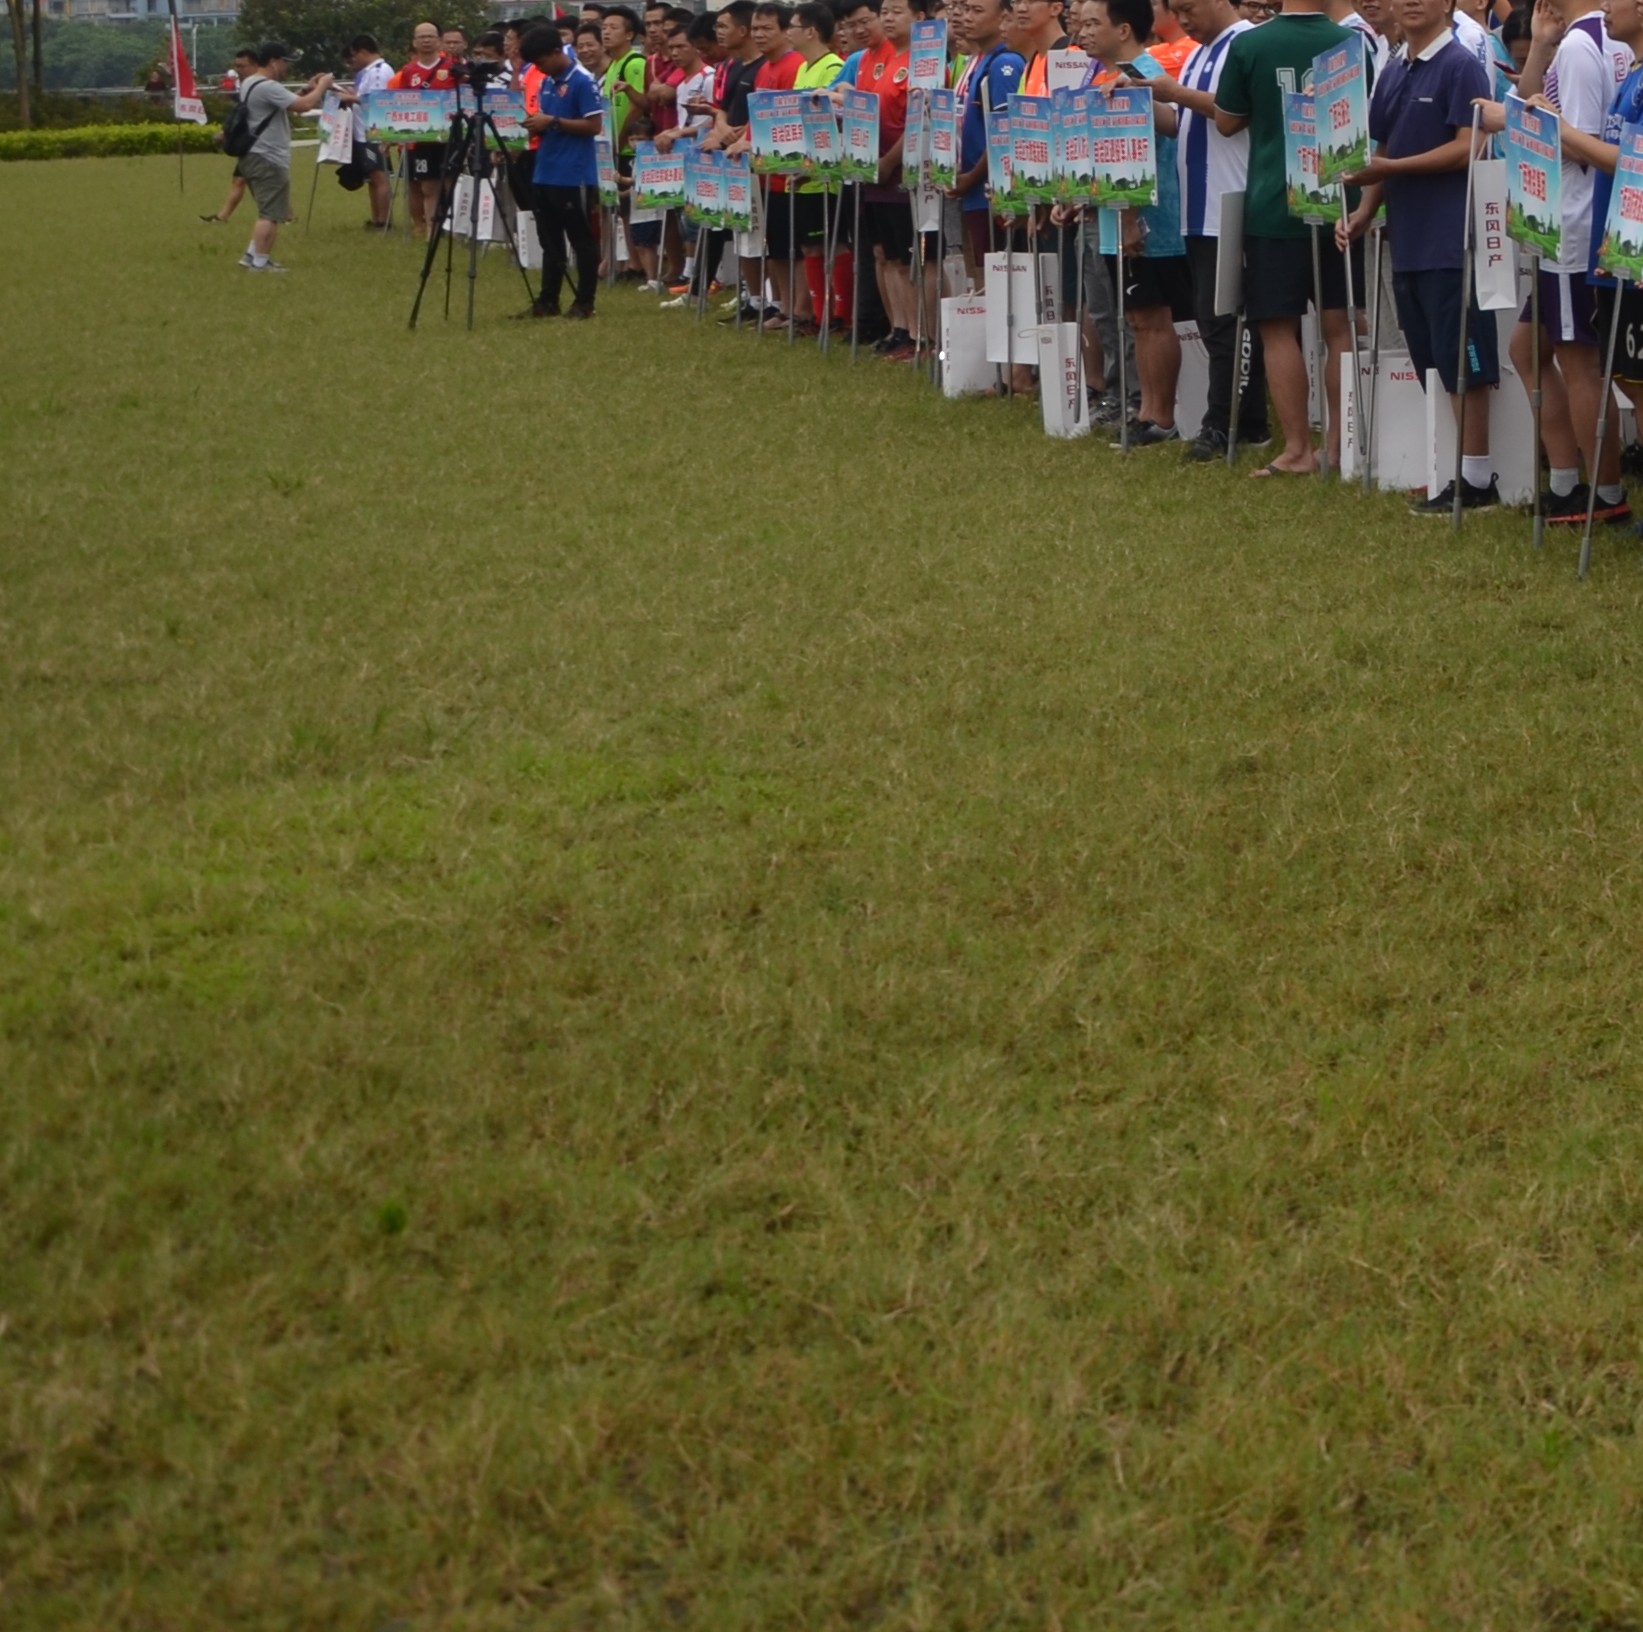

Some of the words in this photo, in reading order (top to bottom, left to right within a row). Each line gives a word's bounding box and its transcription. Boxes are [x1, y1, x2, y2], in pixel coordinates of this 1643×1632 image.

[1484, 201, 1503, 268] 东风日产
[992, 264, 1027, 273] NISAN
